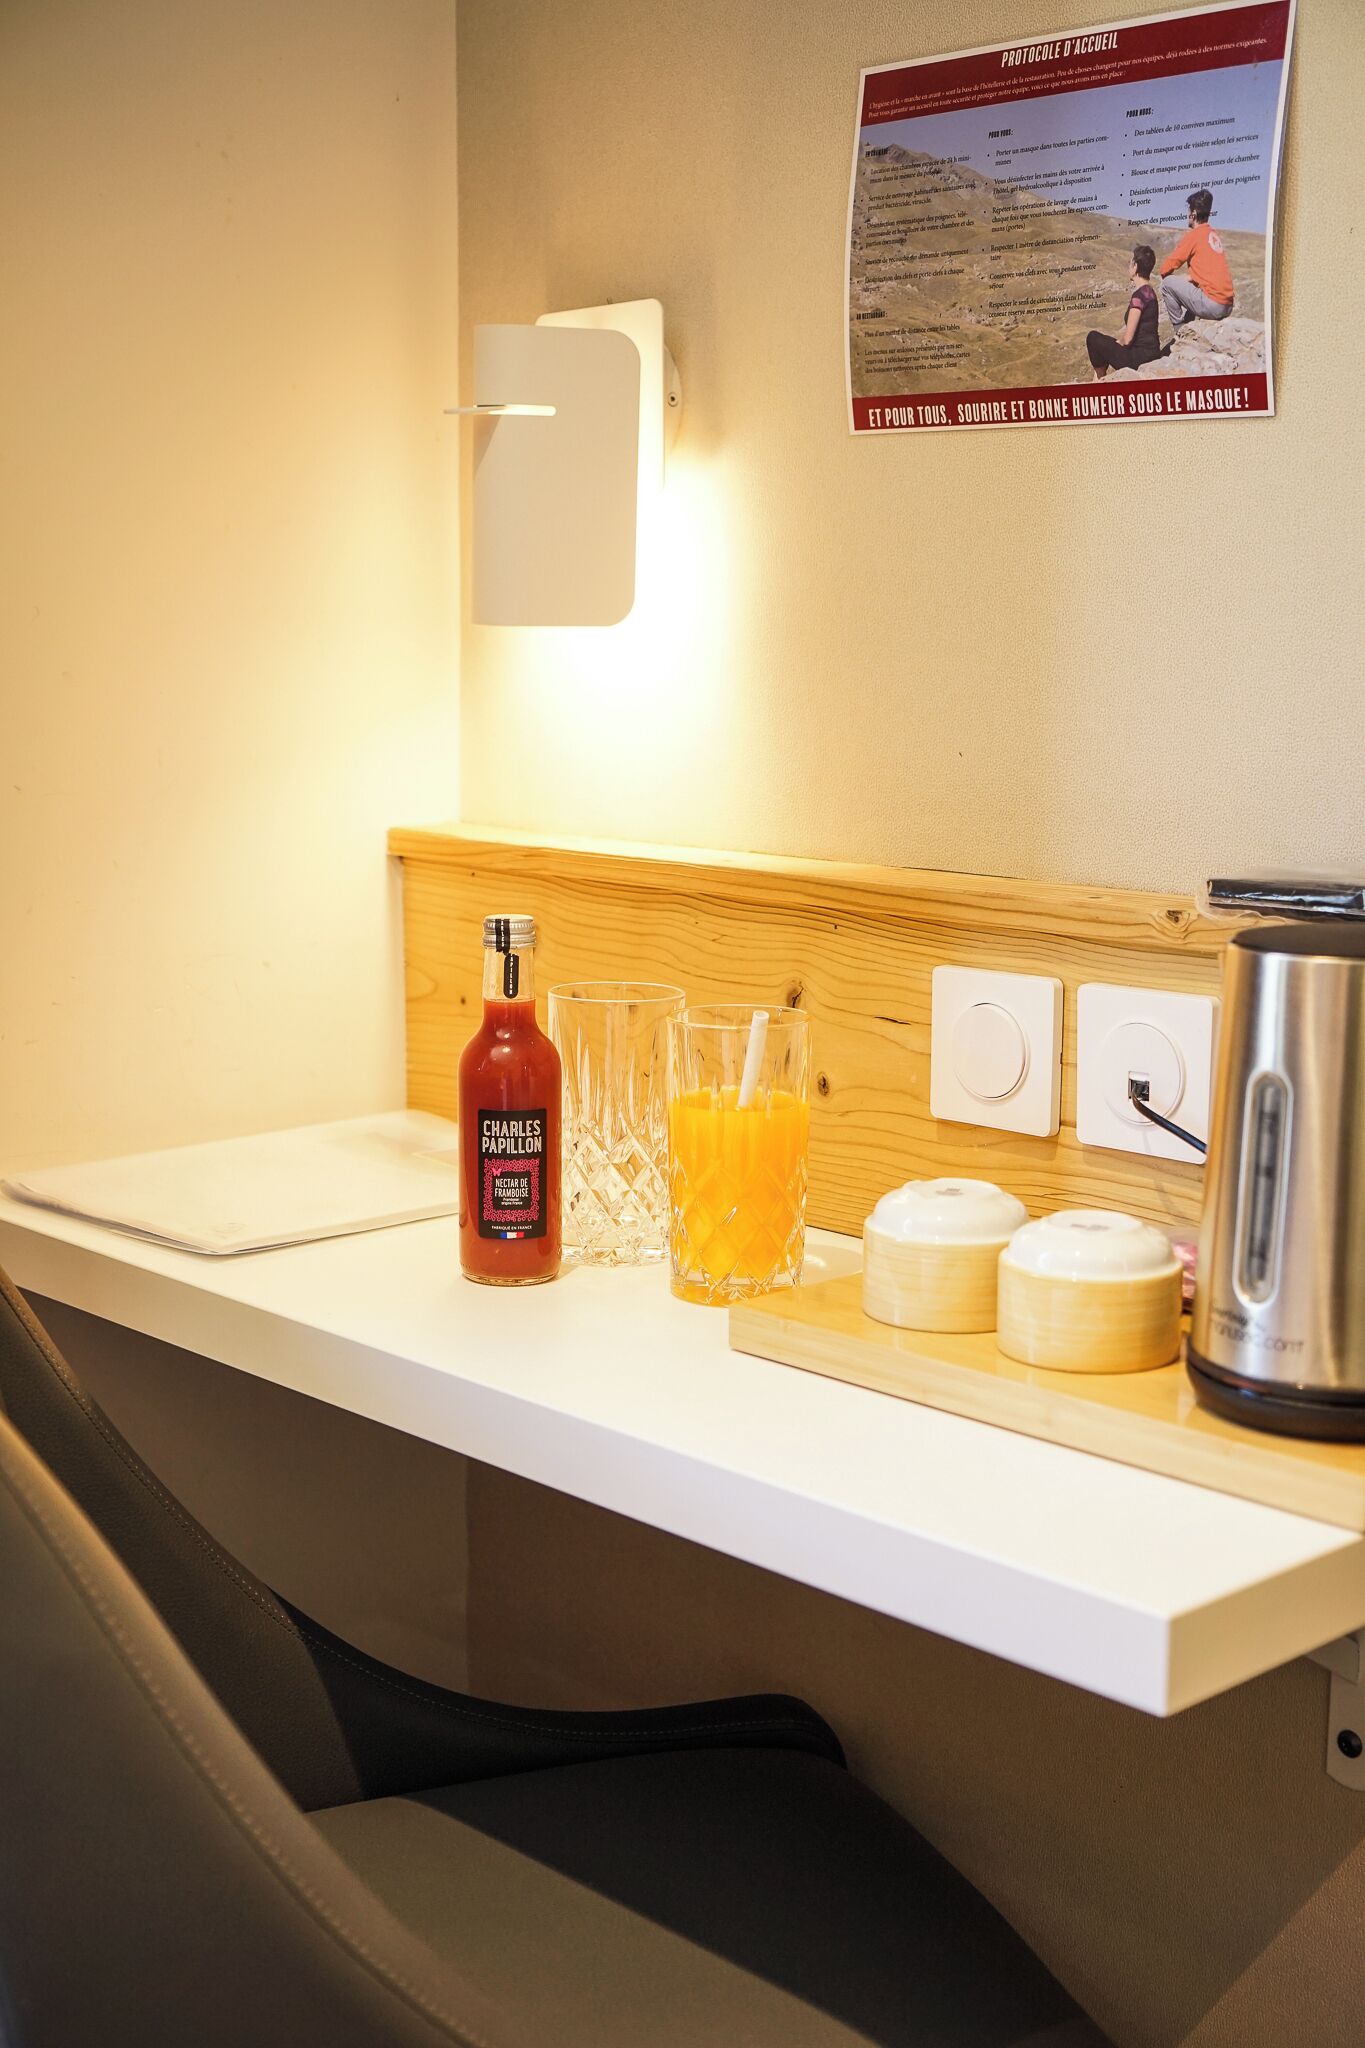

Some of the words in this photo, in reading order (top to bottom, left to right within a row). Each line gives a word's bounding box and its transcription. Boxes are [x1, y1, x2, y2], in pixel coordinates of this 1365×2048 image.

[1001, 41, 1061, 67] PROTOCOLE
[1063, 31, 1118, 56] D'ACCUEIL
[1092, 62, 1116, 71] changent
[1117, 60, 1130, 68] pour
[1213, 43, 1234, 51] normes
[1145, 127, 1163, 135] tablées
[1173, 123, 1180, 131] 10
[1181, 121, 1204, 130] convives
[1205, 117, 1234, 126] maximum
[1076, 137, 1094, 146] parties
[1192, 140, 1210, 148] visière
[1236, 134, 1258, 142] services
[1203, 159, 1225, 167] femmes
[1234, 154, 1259, 162] chambre
[1006, 174, 1033, 183] désinfecter
[1082, 164, 1100, 172] arrivée
[1063, 176, 1091, 185] disposition
[1129, 187, 1163, 196] Désinfection
[1164, 184, 1188, 193] plusieurs
[1211, 179, 1223, 187] jour
[1235, 174, 1260, 184] poignées
[1019, 202, 1045, 210] opérations
[1136, 198, 1150, 206] porte
[1127, 218, 1148, 226] Respect
[1159, 213, 1187, 223] protocoles
[1006, 222, 1025, 232] (portes)
[1061, 265, 1081, 273] pendant
[868, 407, 881, 427] ET
[884, 406, 915, 426] POUR
[916, 404, 951, 425] TOUS,
[957, 401, 1006, 423] SOURIRE
[1011, 400, 1024, 421] ET
[1029, 397, 1069, 419] BONNE
[1071, 394, 1124, 417] HUMEUR
[1128, 392, 1163, 415] SOUS
[1165, 391, 1181, 413] LE
[483, 1120, 541, 1137] CHARLES
[481, 1136, 542, 1154] PAPILLON
[495, 1178, 519, 1188] NECTAR
[520, 1177, 528, 1188] DE
[494, 1187, 529, 1198] FRAMBOISE
